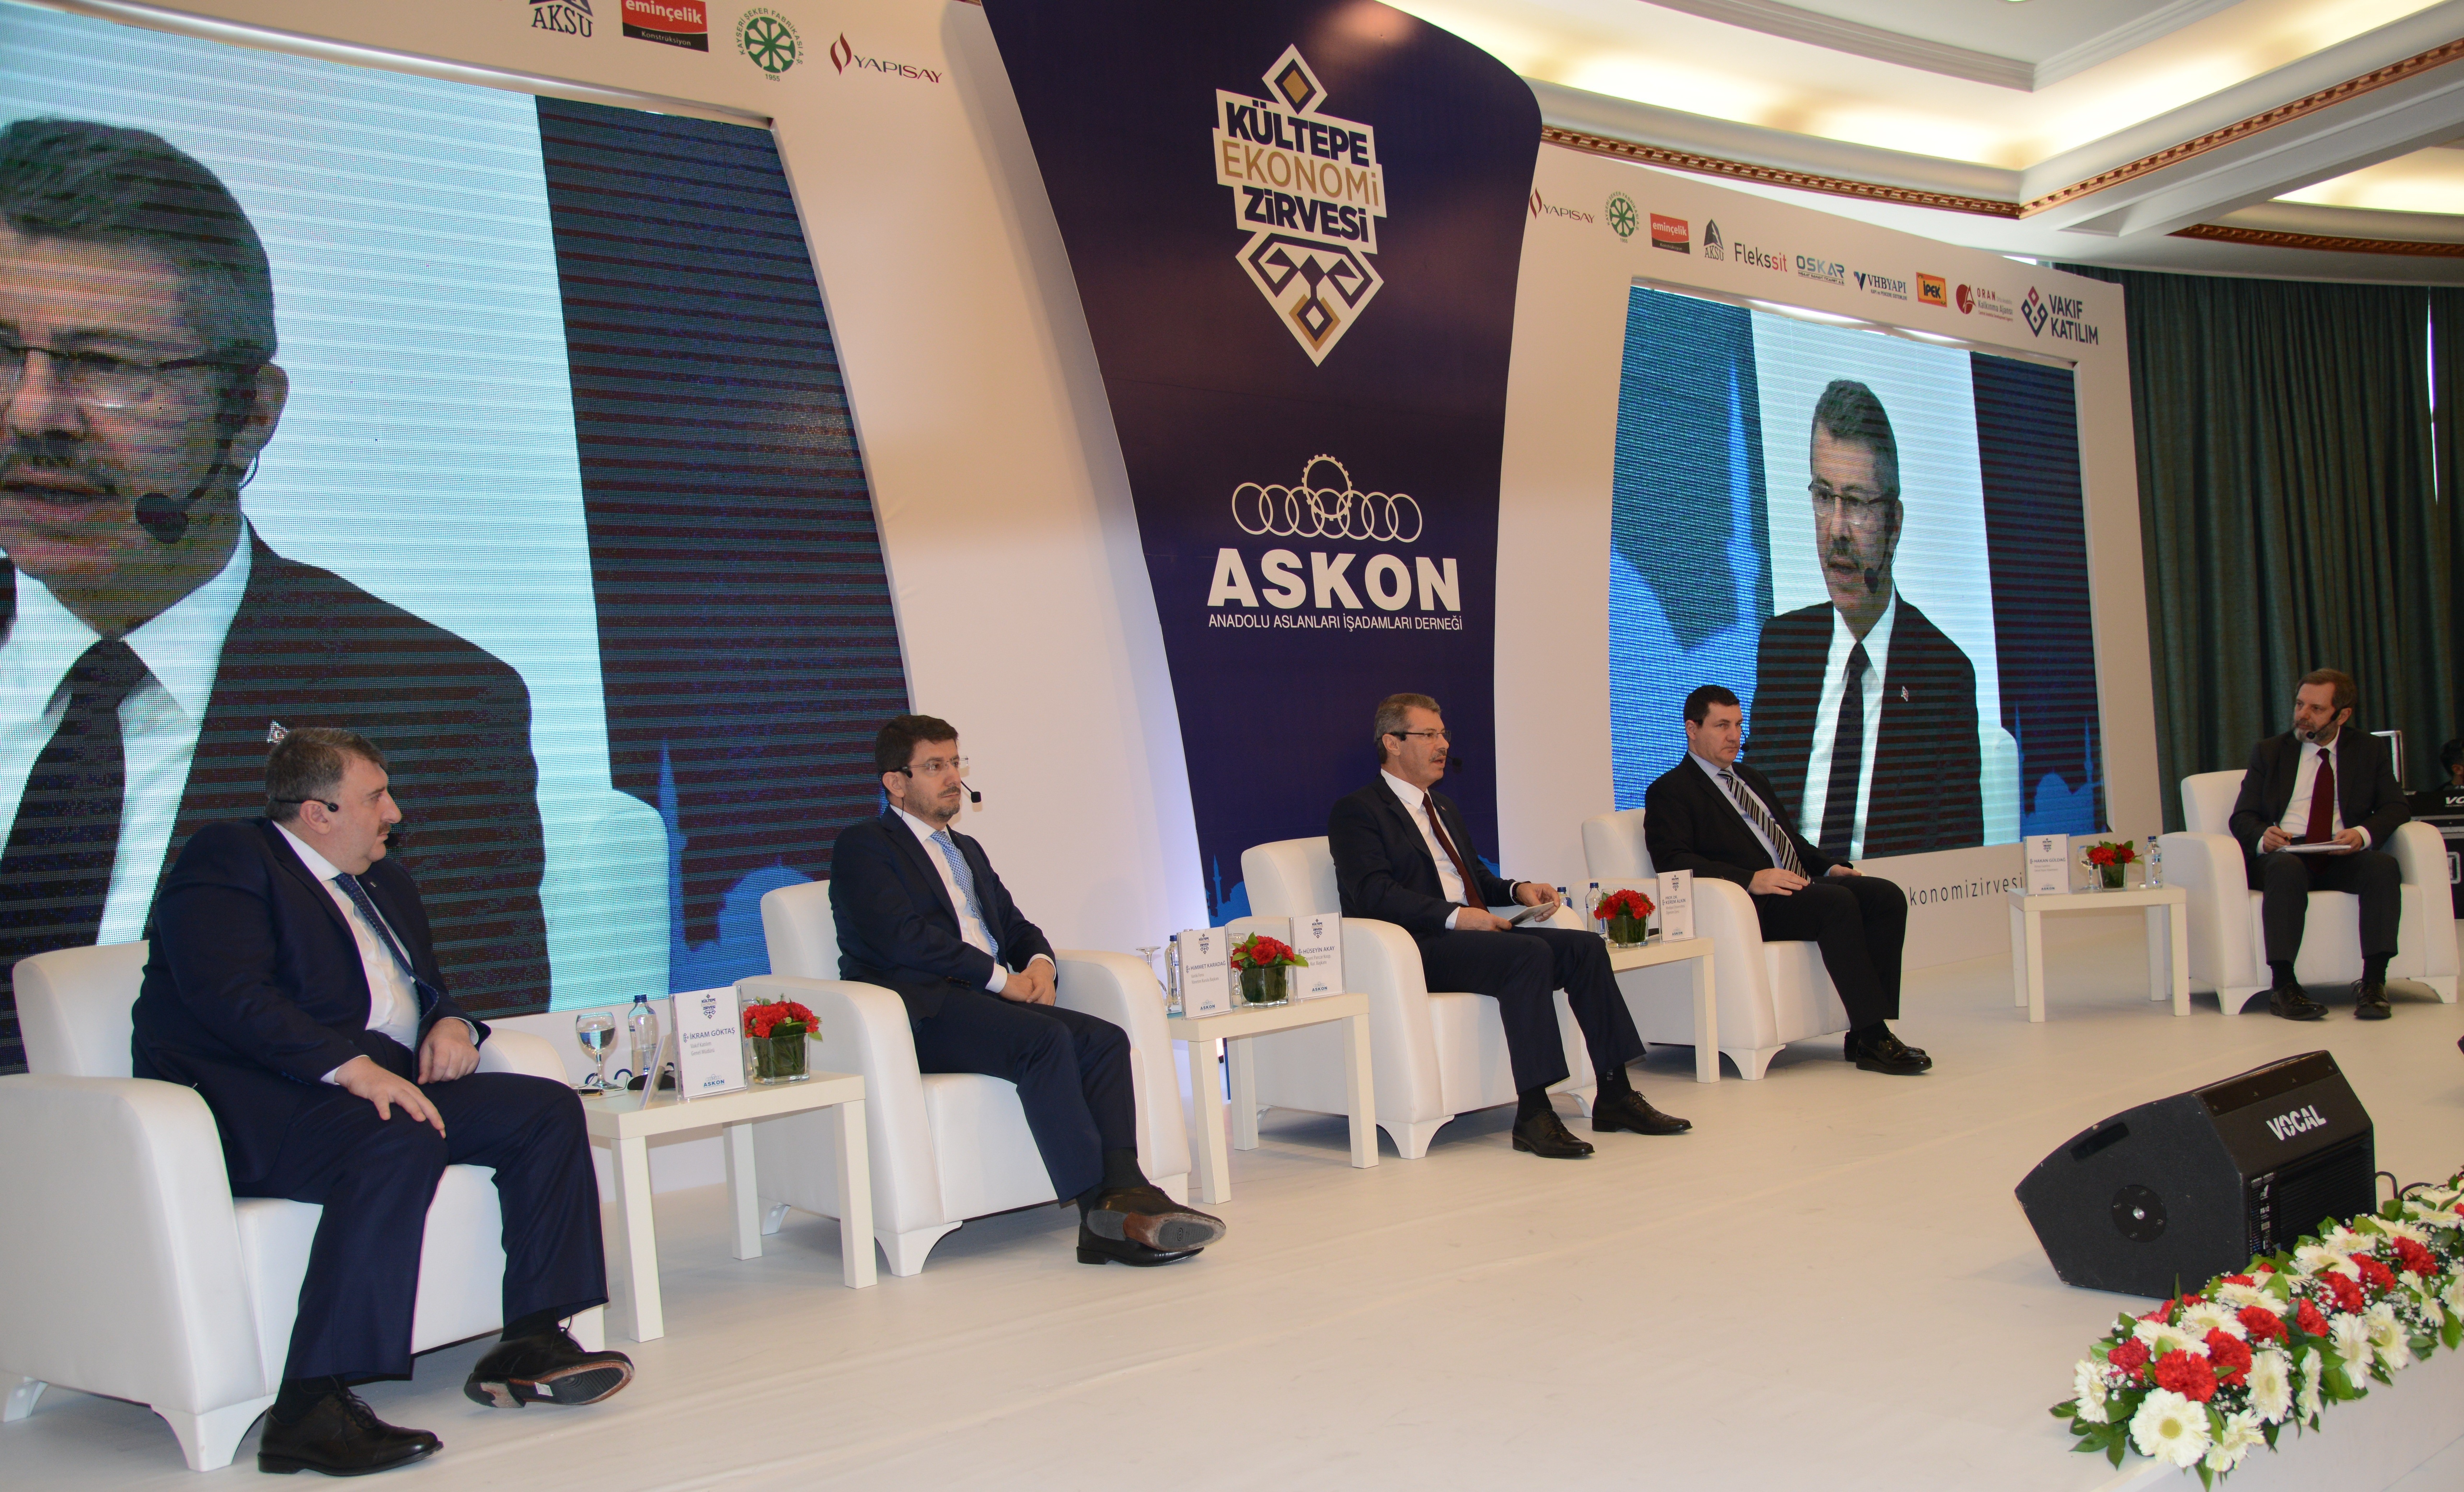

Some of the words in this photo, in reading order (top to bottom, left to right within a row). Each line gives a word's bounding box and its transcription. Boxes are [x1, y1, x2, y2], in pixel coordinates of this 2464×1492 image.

[532, 5, 593, 37] AKSU
[626, 0, 702, 24] eminçelik
[642, 31, 691, 46] Konstrüksiyon
[736, 17, 746, 55] KAYSERİ
[744, 8, 768, 20] ŞEKER
[772, 10, 803, 49] FABRİKASI
[765, 73, 780, 82] 1955
[853, 55, 942, 83] YAPISAY
[1226, 100, 1369, 167] KÜLTEPE
[1543, 204, 1595, 224] YAPISAY
[1653, 222, 1687, 236] eminçelik
[1705, 245, 1724, 261] AKSU
[1734, 243, 1787, 272] Flekssit
[1796, 255, 1844, 278] OSKAR
[1867, 274, 1907, 294] VHBYAPI
[1977, 288, 1995, 301] ORAN
[2049, 294, 2083, 319] VAKIF
[2051, 318, 2098, 345] KATILIM
[1208, 548, 1461, 611] ASKON
[1209, 614, 1270, 628] ANADOLU
[1274, 615, 1340, 628] ASLANLARI
[1344, 613, 1412, 632] İŞADAMLARI
[1415, 615, 1462, 630] DERNEĞİ
[1909, 872, 2022, 906] konomizirvesi
[690, 1031, 710, 1040] İKRAM
[711, 1027, 735, 1037] GÖKTAŞ
[703, 1079, 725, 1087] ASKON
[2266, 1105, 2326, 1141] VOCAL
